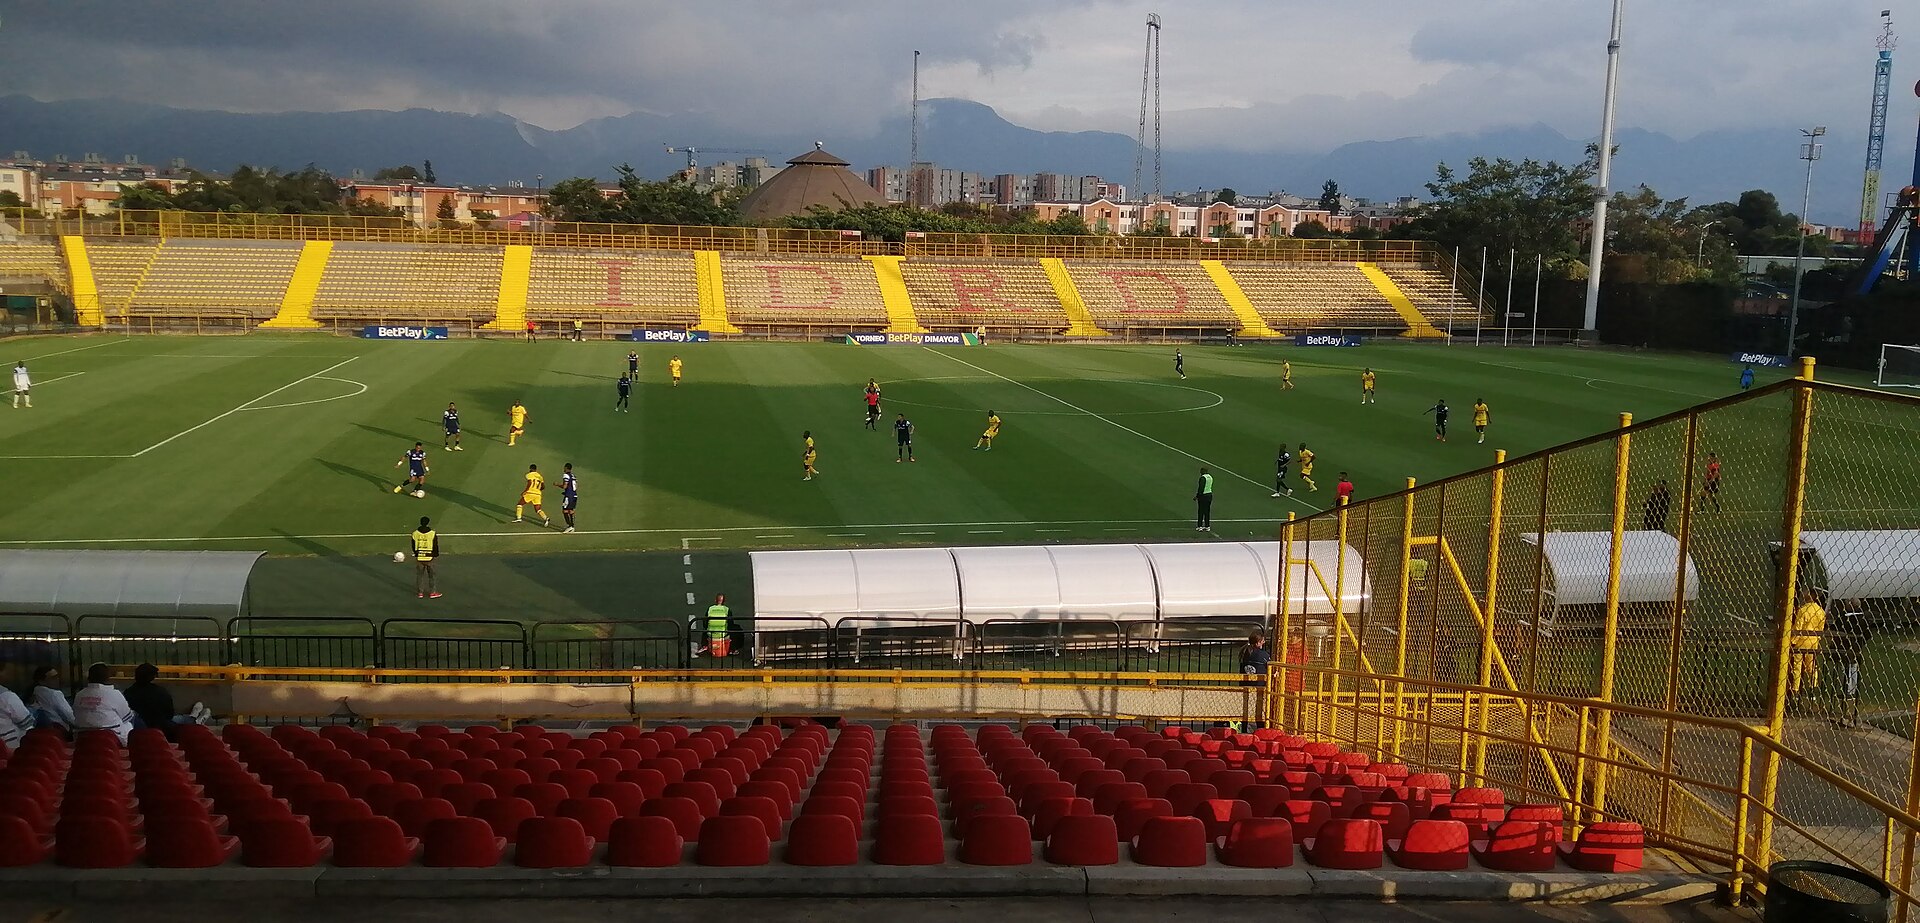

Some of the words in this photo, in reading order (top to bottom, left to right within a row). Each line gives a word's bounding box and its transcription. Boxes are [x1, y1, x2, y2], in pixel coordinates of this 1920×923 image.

[378, 327, 421, 339] BetPlay
[645, 330, 685, 342] BetPlay
[888, 333, 923, 343] BetPlay
[924, 335, 959, 343] DIMAYOR
[1306, 335, 1341, 346] BetPlay
[1740, 353, 1771, 365] BetPlay
